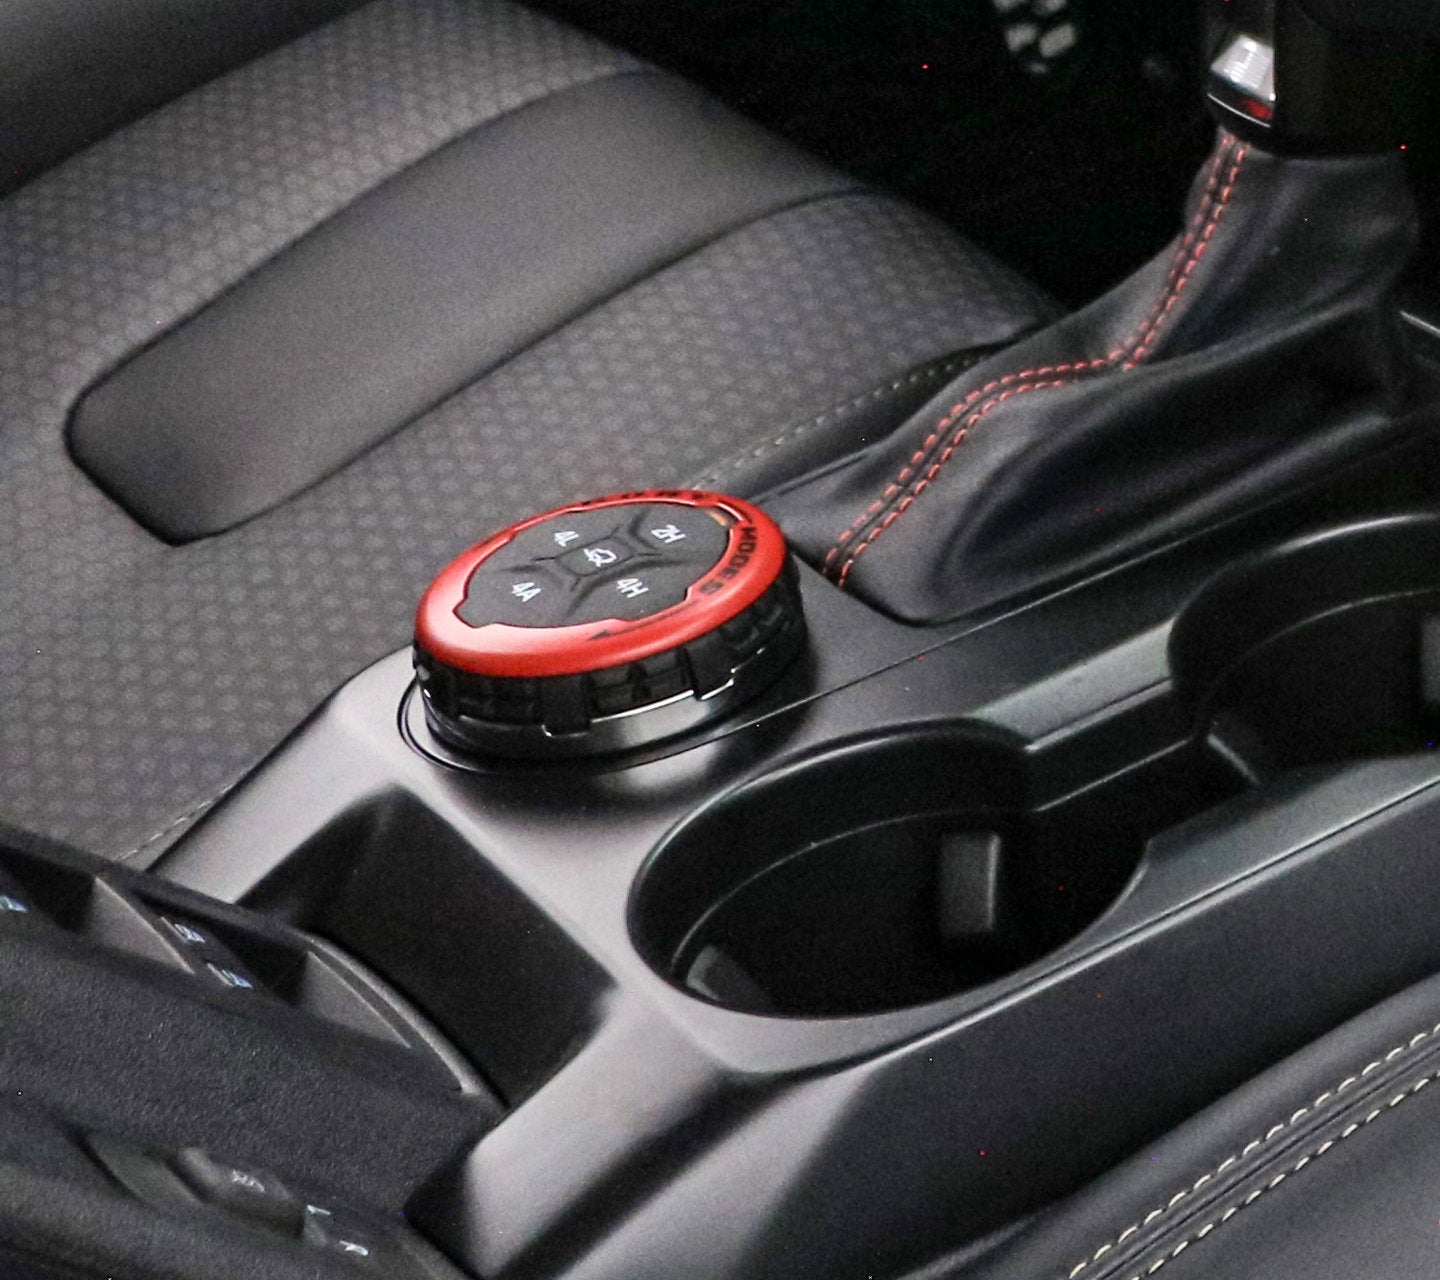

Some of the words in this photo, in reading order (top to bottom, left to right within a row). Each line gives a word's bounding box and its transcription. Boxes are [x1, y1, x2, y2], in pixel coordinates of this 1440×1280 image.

[553, 529, 580, 547] 4L
[650, 523, 687, 544] 2H
[511, 581, 542, 603] 4A
[616, 577, 650, 599] 4H
